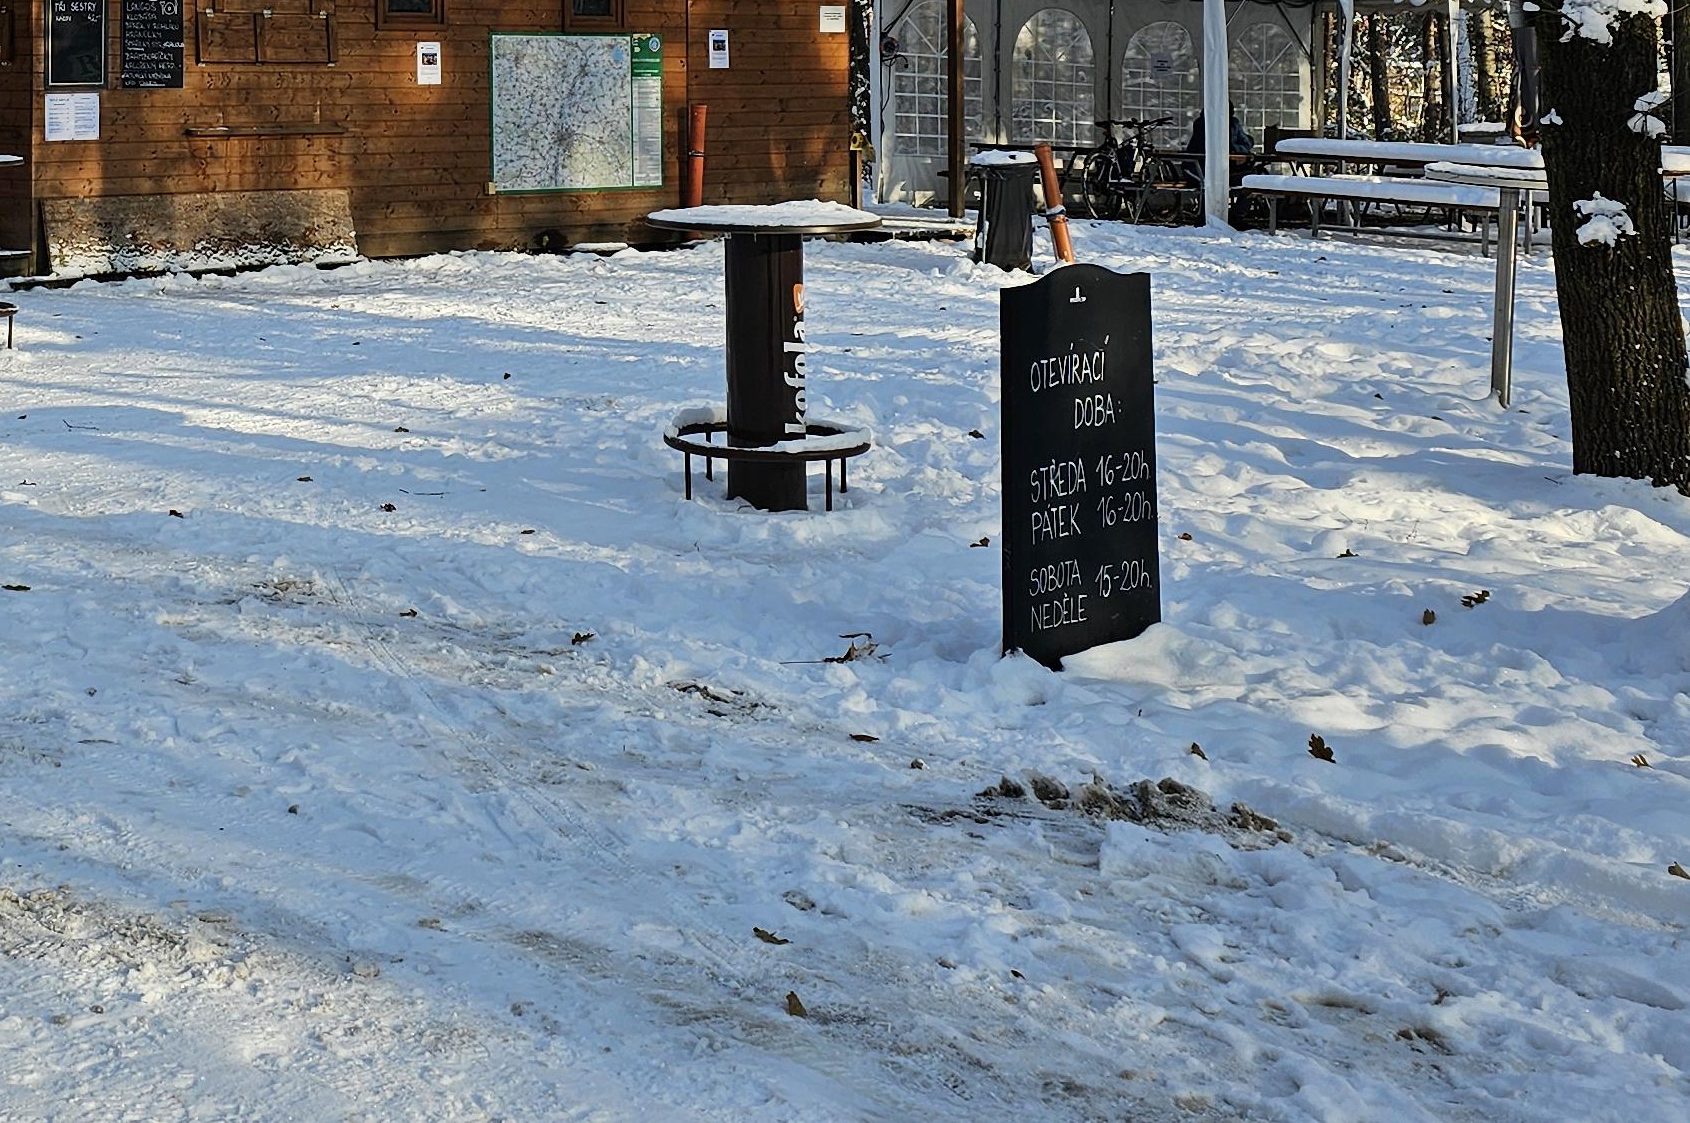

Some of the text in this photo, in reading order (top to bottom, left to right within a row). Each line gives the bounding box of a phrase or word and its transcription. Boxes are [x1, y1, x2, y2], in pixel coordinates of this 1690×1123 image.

[1030, 335, 1110, 393] OTEVÍRACÍ
[1074, 393, 1122, 430] DOBA:
[1030, 458, 1087, 503] STŘEDA
[1031, 503, 1082, 545] PÁTEK
[1029, 559, 1082, 597] SOBOTA
[1030, 592, 1088, 633] NEDĚLE
